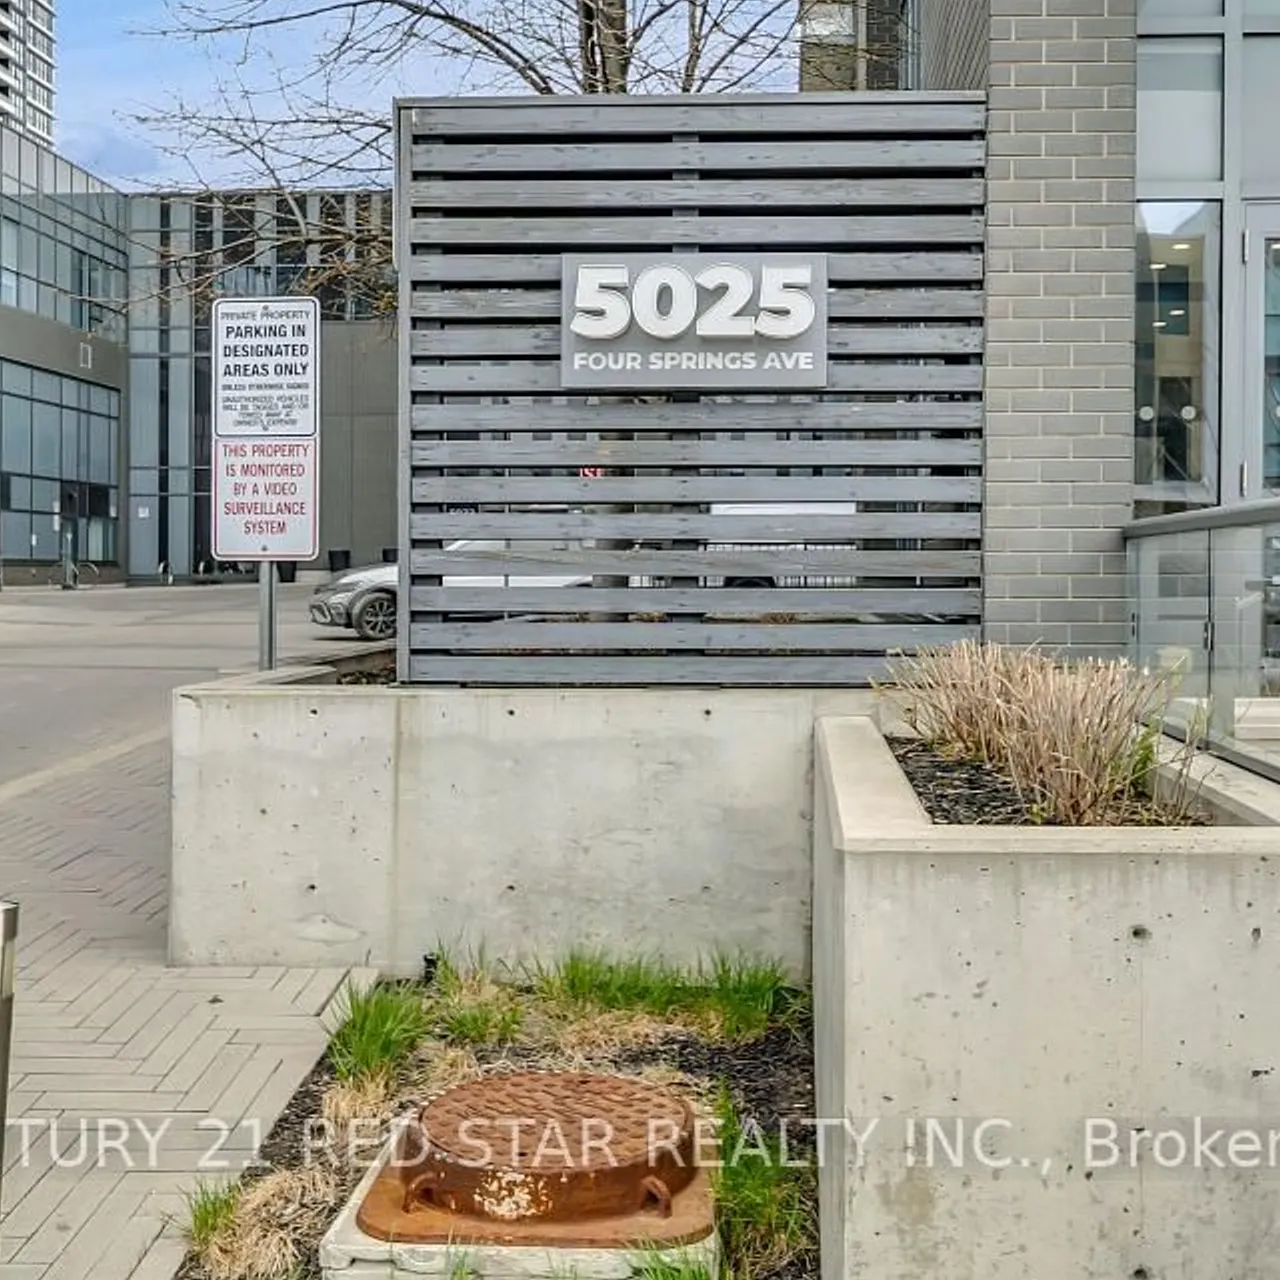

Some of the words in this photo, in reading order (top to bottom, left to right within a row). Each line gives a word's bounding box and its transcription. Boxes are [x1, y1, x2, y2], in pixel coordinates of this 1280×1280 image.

[570, 263, 815, 339] 5025
[261, 310, 311, 320] PROPERTY
[226, 324, 287, 338] PARKING
[292, 324, 306, 337] IN
[223, 344, 309, 357] DESIGNATED
[574, 352, 641, 370] FOUR
[648, 352, 757, 370] SPRINGS
[763, 352, 814, 370] AVE
[223, 364, 269, 377] AREAS
[274, 362, 309, 376] ONLY
[222, 444, 247, 457] THIS
[252, 444, 309, 457] PROPERTY
[226, 464, 236, 477] IS
[240, 464, 305, 477] MONITORED
[233, 482, 247, 496] BY
[252, 482, 259, 495] A
[264, 482, 297, 495] VIDEO
[224, 502, 306, 515] SURVEILLANCE
[244, 520, 287, 534] SYSTEM
